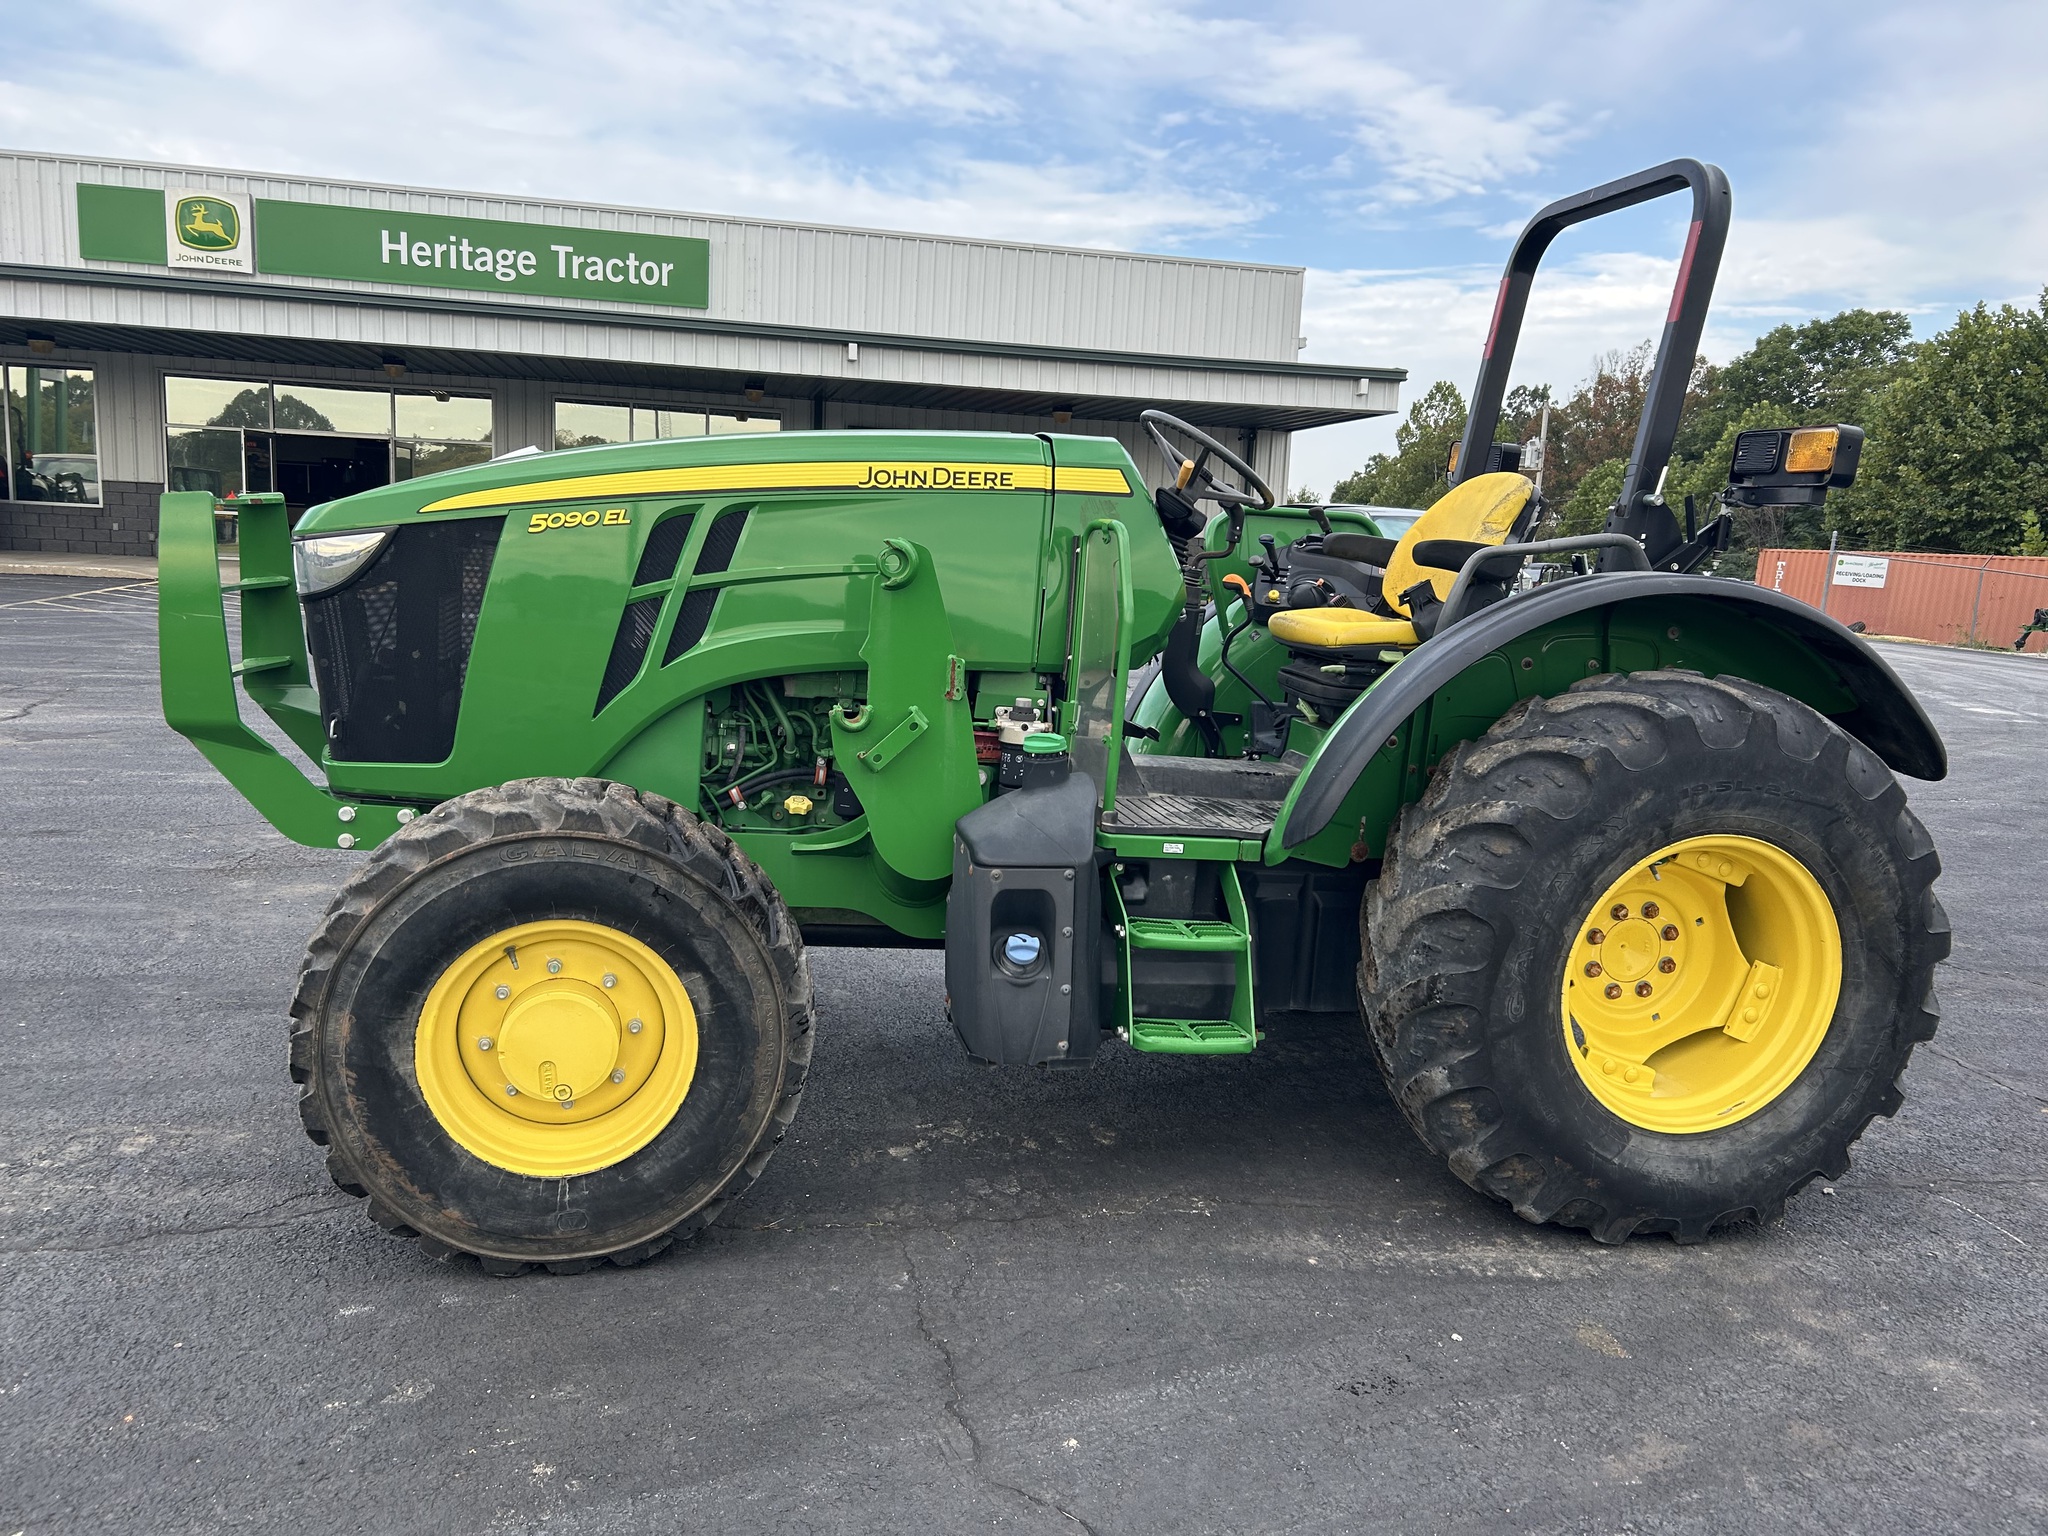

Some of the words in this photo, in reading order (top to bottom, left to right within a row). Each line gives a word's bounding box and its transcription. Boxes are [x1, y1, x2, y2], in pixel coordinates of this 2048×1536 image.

[176, 253, 204, 263] JOHN
[206, 255, 243, 266] DEERE
[381, 229, 537, 282] Heritage
[550, 244, 674, 287] Tractor
[858, 466, 927, 486] JOHN
[932, 467, 1014, 487] DEERE
[527, 510, 602, 534] 5090
[602, 508, 632, 526] EL
[499, 840, 709, 899] GALAXY
[1507, 803, 1632, 1023] GALAXY
